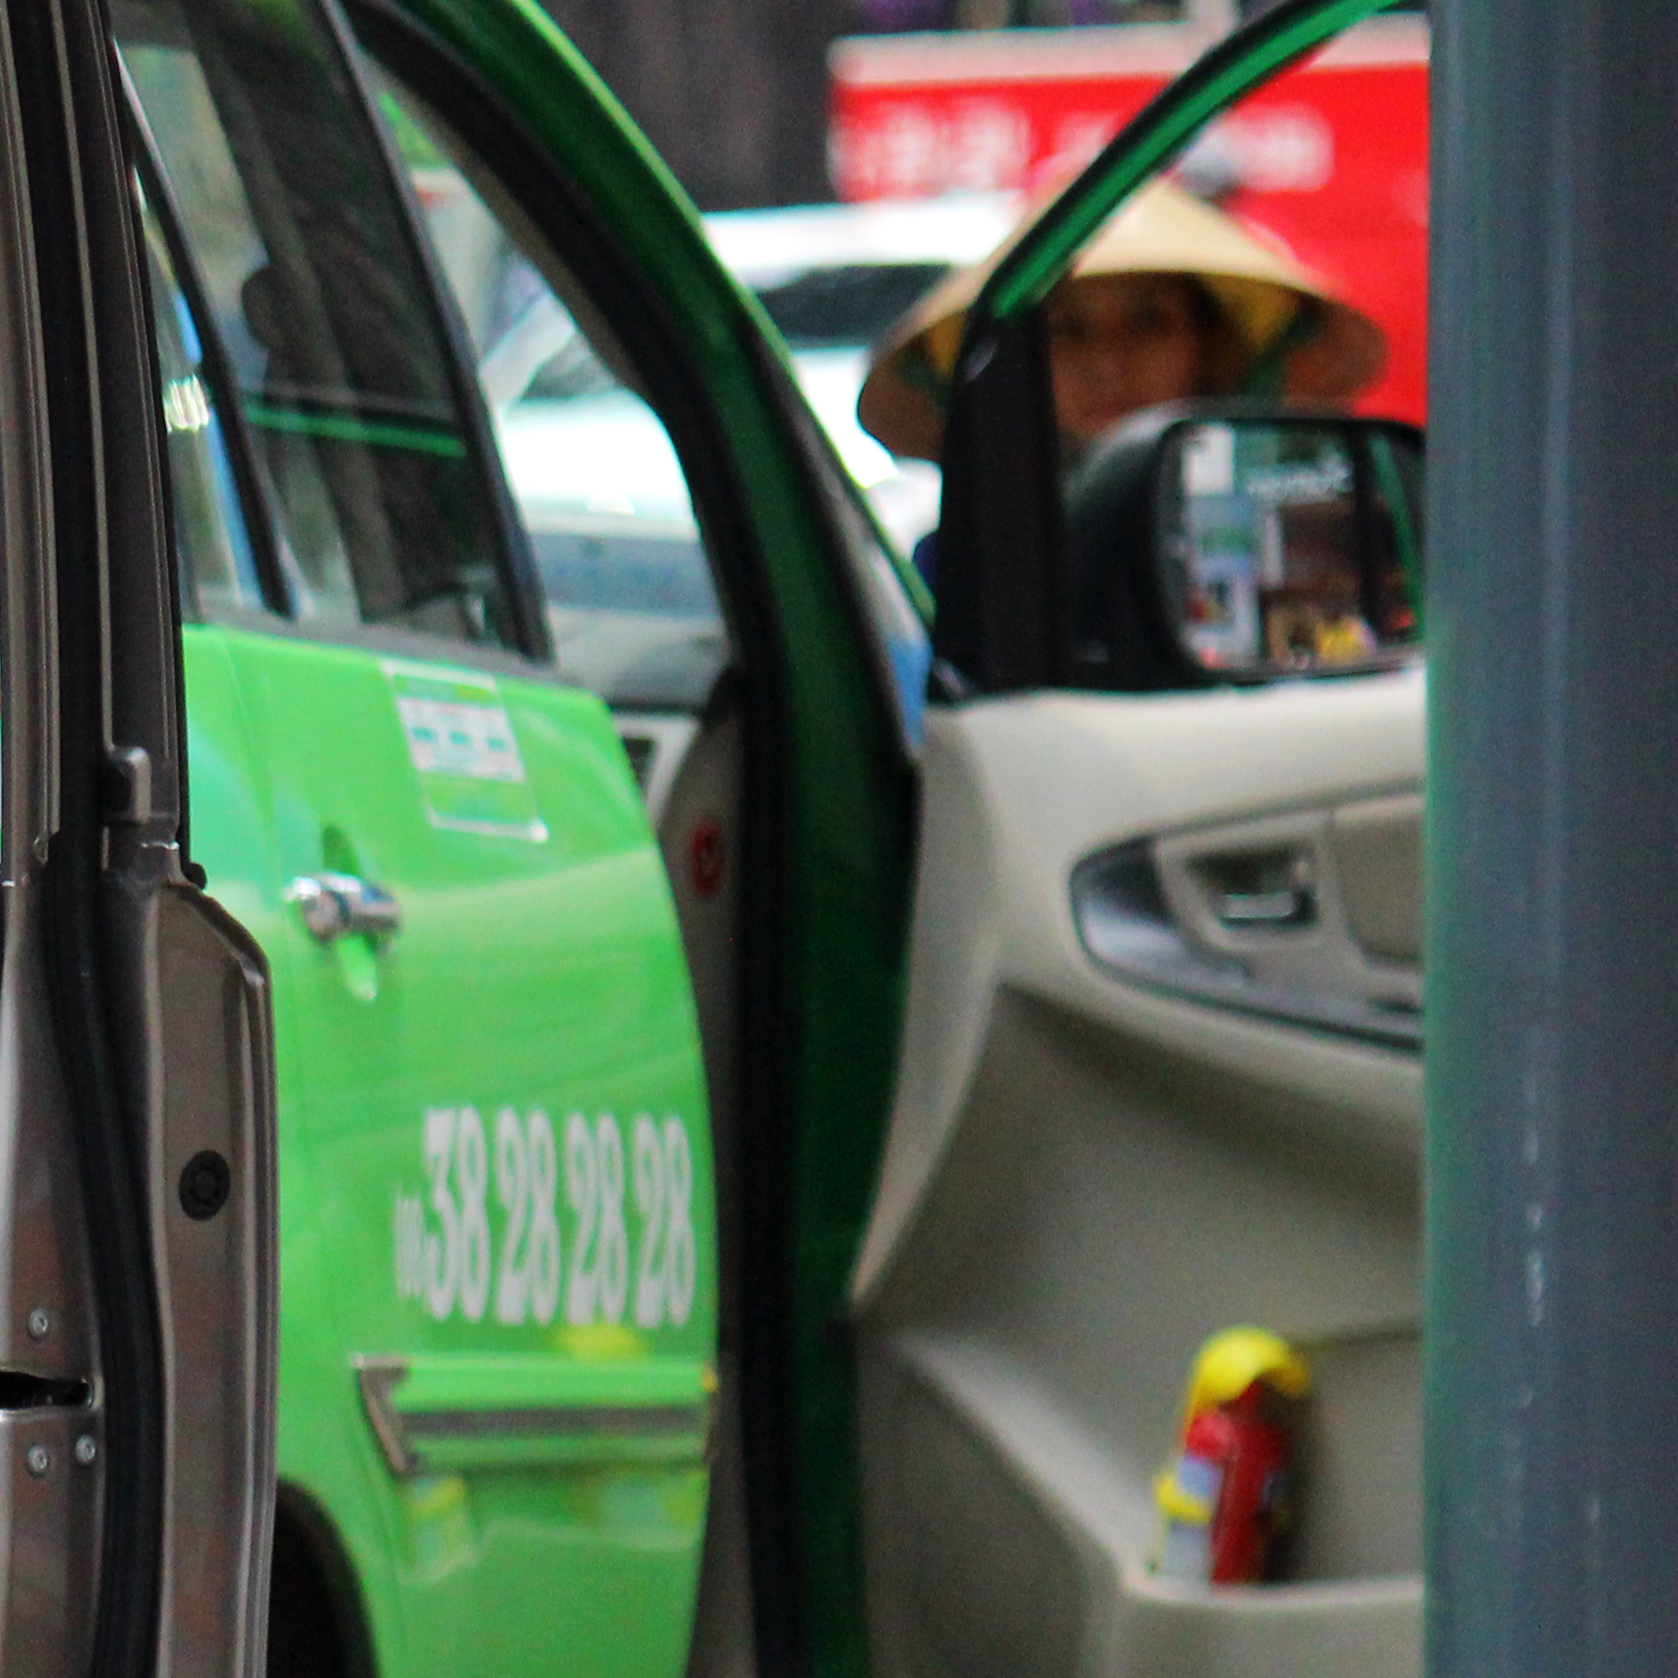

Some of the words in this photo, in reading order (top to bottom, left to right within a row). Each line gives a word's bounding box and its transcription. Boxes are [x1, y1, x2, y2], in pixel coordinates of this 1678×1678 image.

[424, 1105, 491, 1324] 38
[495, 1106, 561, 1327] 28
[566, 1111, 630, 1327] 28
[632, 1114, 697, 1330] 28
